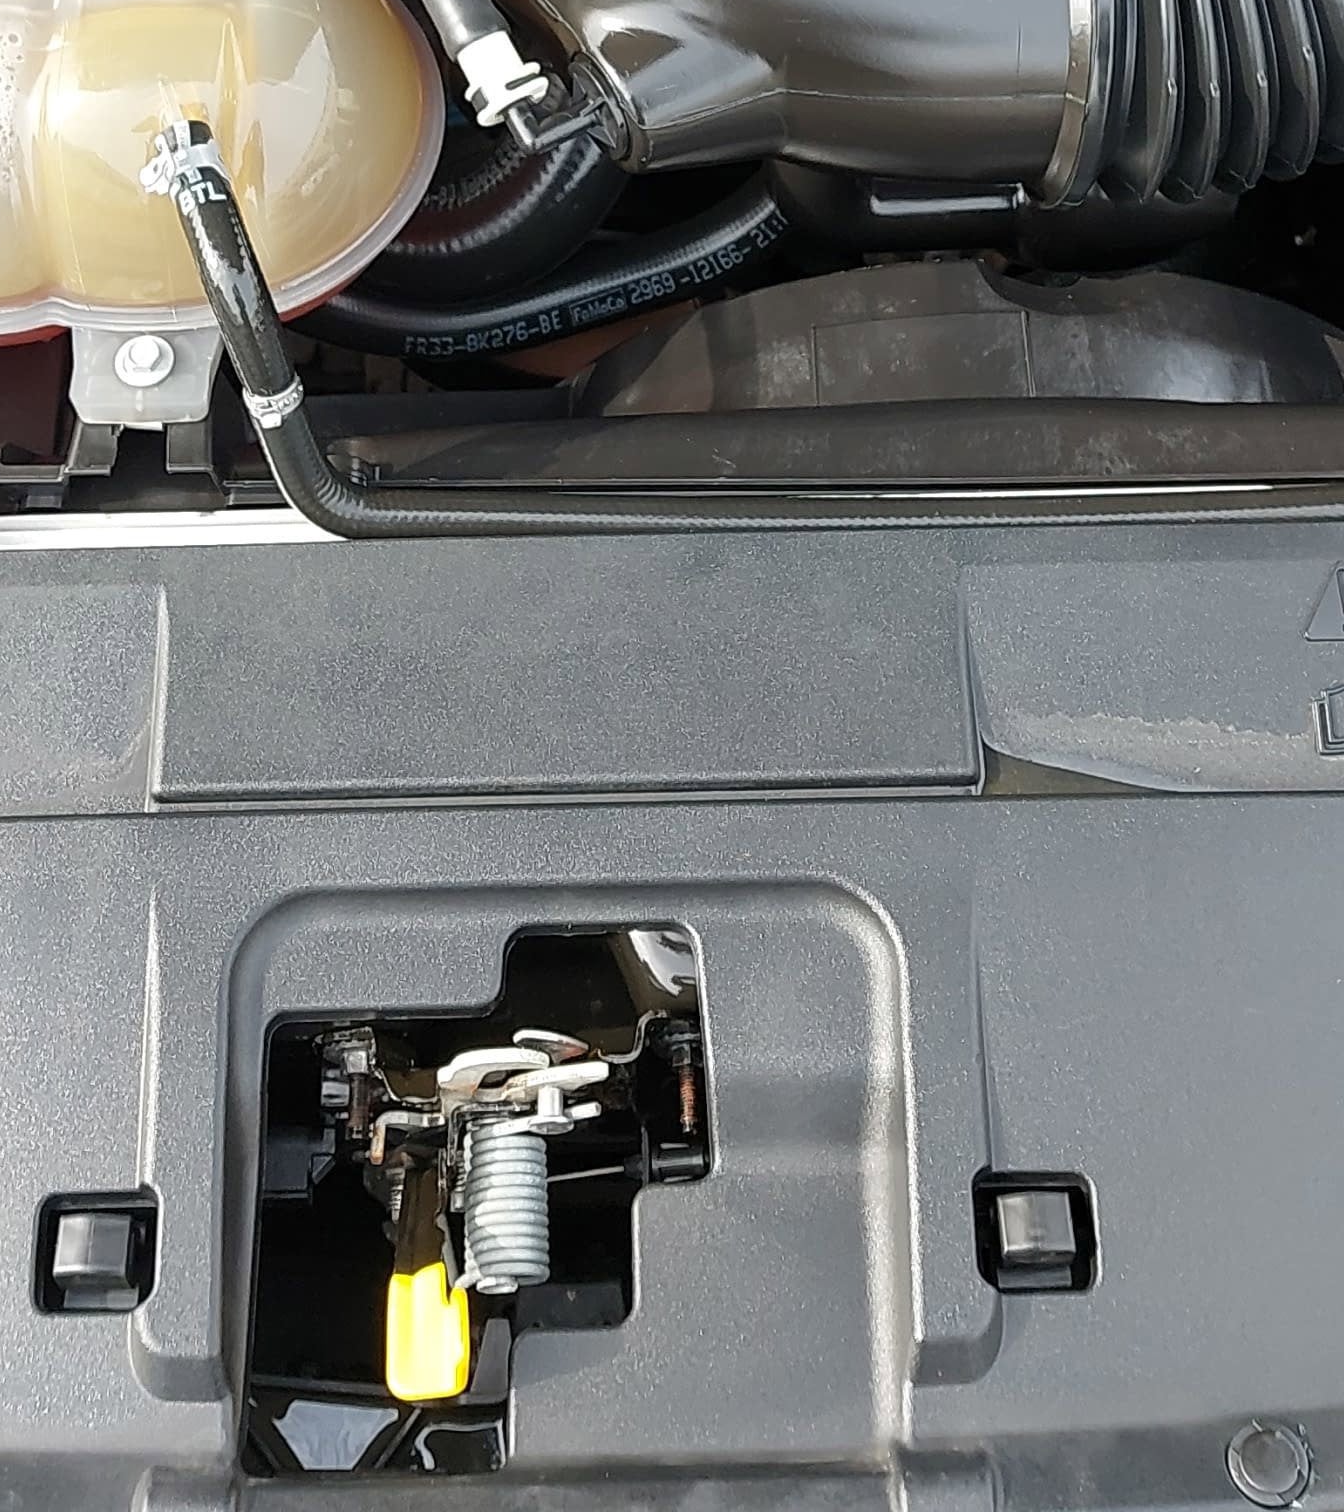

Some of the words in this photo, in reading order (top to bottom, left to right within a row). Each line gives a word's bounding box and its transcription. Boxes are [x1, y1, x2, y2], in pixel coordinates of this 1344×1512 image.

[178, 180, 228, 216] BTL
[573, 294, 626, 324] FoMoCo
[629, 272, 677, 305] 2969
